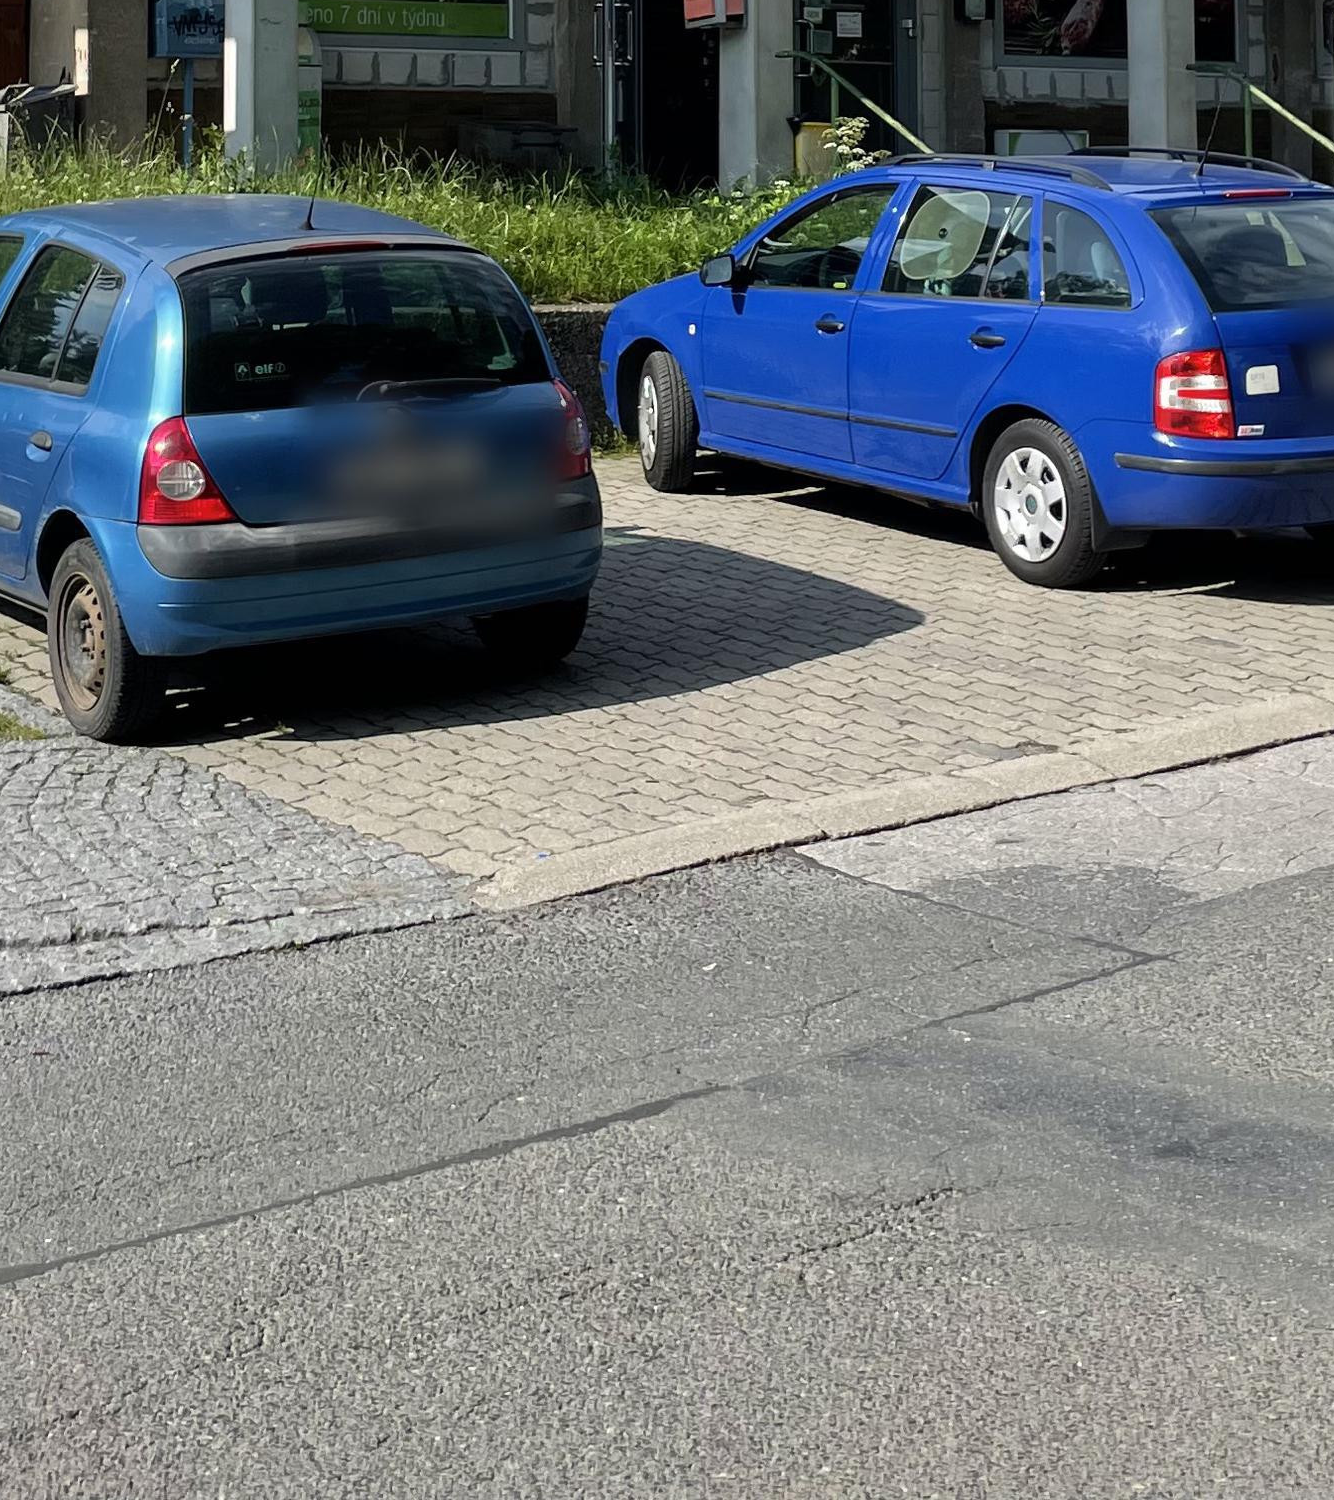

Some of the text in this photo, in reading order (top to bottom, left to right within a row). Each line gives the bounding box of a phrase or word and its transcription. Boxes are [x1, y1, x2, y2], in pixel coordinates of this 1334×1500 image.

[339, 4, 352, 24] 7
[357, 5, 381, 25] dní
[387, 11, 397, 25] v
[402, 7, 446, 30] týdnu
[254, 363, 274, 375] elf
